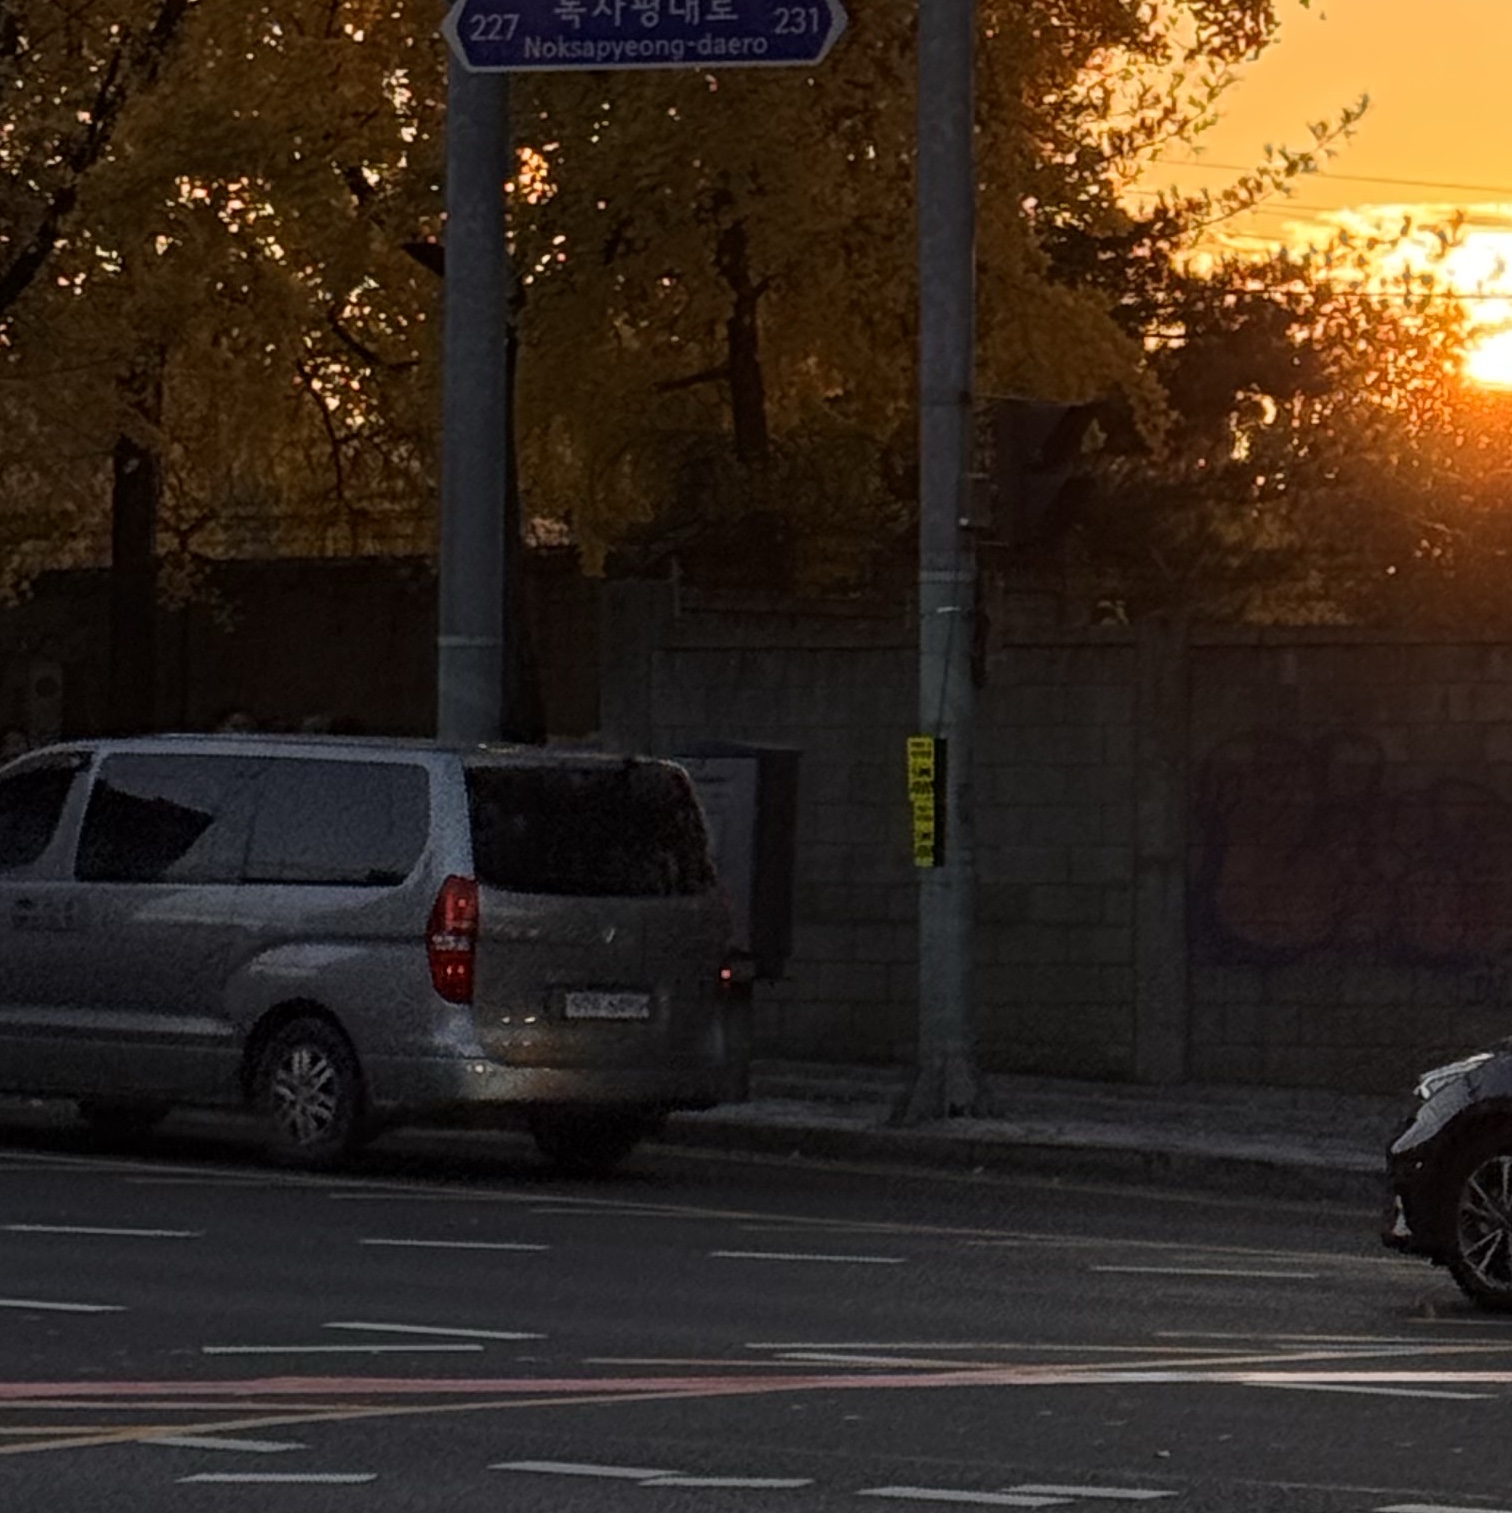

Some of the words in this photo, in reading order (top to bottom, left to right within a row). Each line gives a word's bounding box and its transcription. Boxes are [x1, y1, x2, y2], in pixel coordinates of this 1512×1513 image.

[469, 13, 520, 41] 227
[774, 7, 820, 35] 231
[523, 33, 768, 62] Noksapyeong-daero
